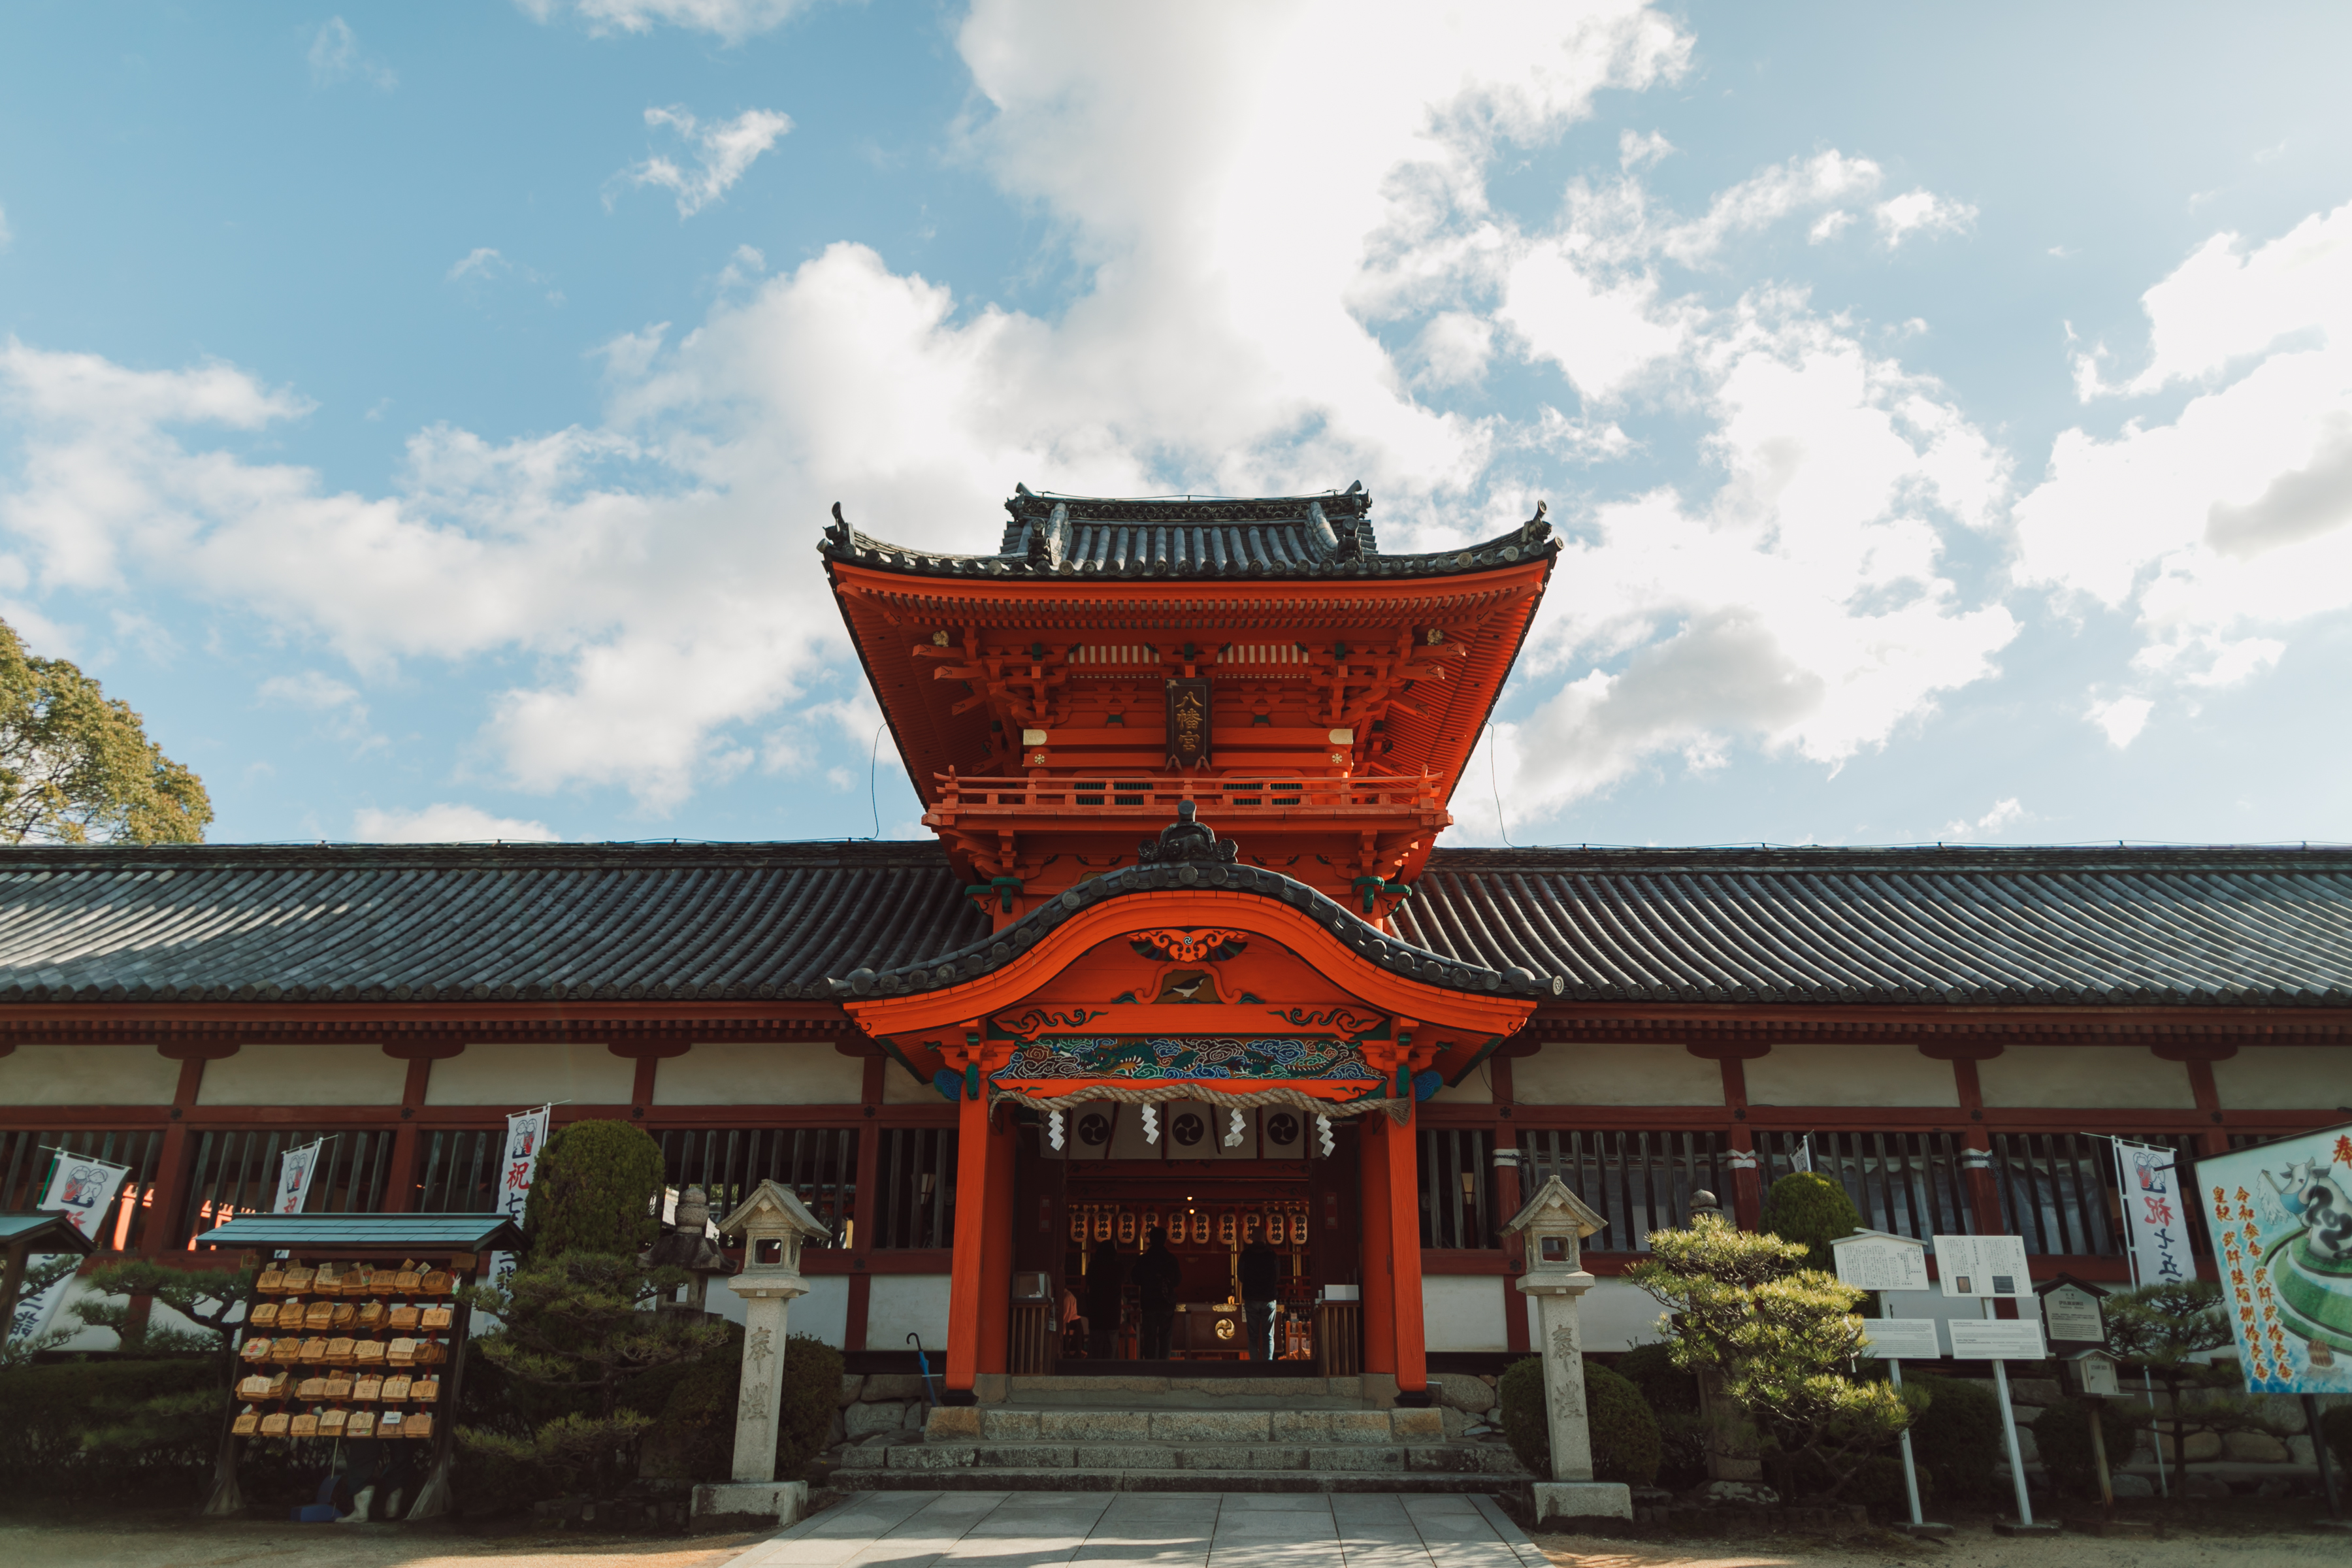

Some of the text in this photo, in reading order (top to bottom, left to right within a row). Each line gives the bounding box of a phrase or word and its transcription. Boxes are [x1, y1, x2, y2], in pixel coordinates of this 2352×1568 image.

[1175, 691, 1203, 752] 八幡宮
[2213, 1186, 2234, 1222] 皇紀
[1074, 1213, 1085, 1238] 御神燈
[1098, 1213, 1108, 1238] 御神燈
[1122, 1214, 1132, 1239] 御神燈
[1172, 1214, 1182, 1239] 御神燈
[1196, 1215, 1207, 1239] 御神燈
[1223, 1215, 1233, 1240] 御神燈
[1271, 1216, 1282, 1241] 御神燈
[1295, 1216, 1305, 1241] 御神燈
[2234, 1186, 2262, 1259] 令和参年
